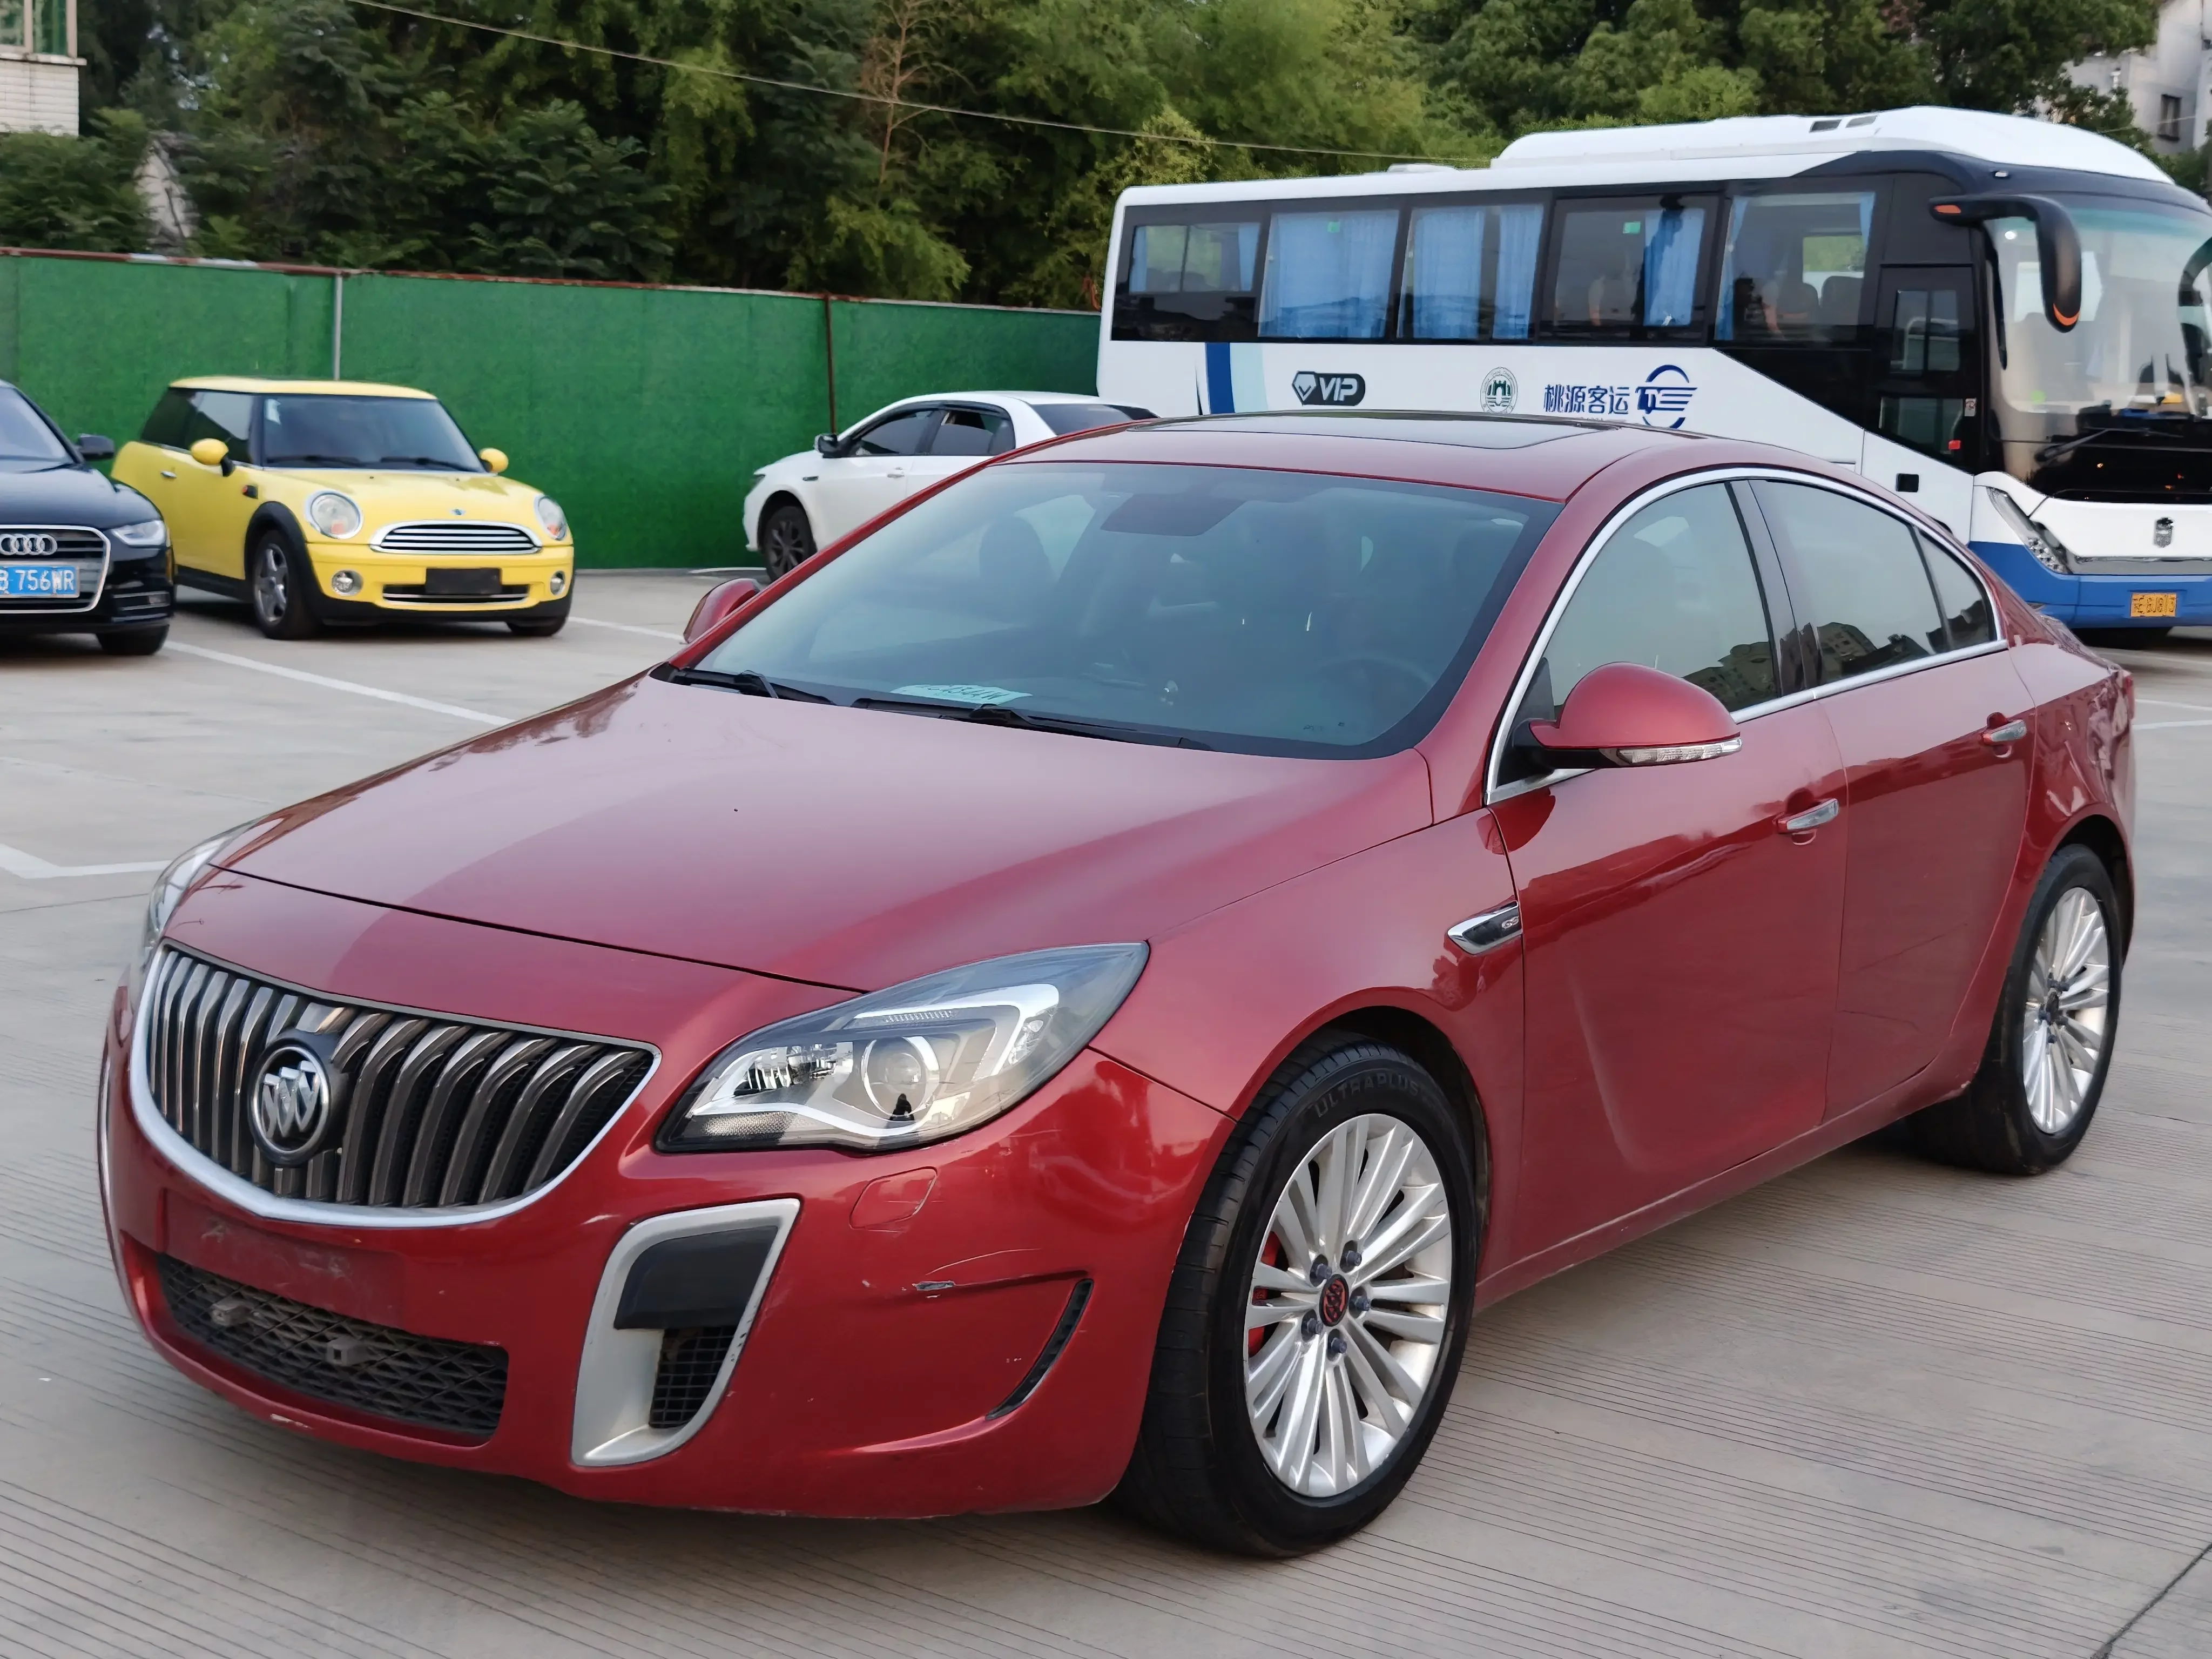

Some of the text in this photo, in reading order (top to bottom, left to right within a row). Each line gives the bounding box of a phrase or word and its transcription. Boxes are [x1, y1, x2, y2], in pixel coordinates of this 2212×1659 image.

[1319, 377, 1358, 401] VIP
[1543, 383, 1630, 415] 桃源客运
